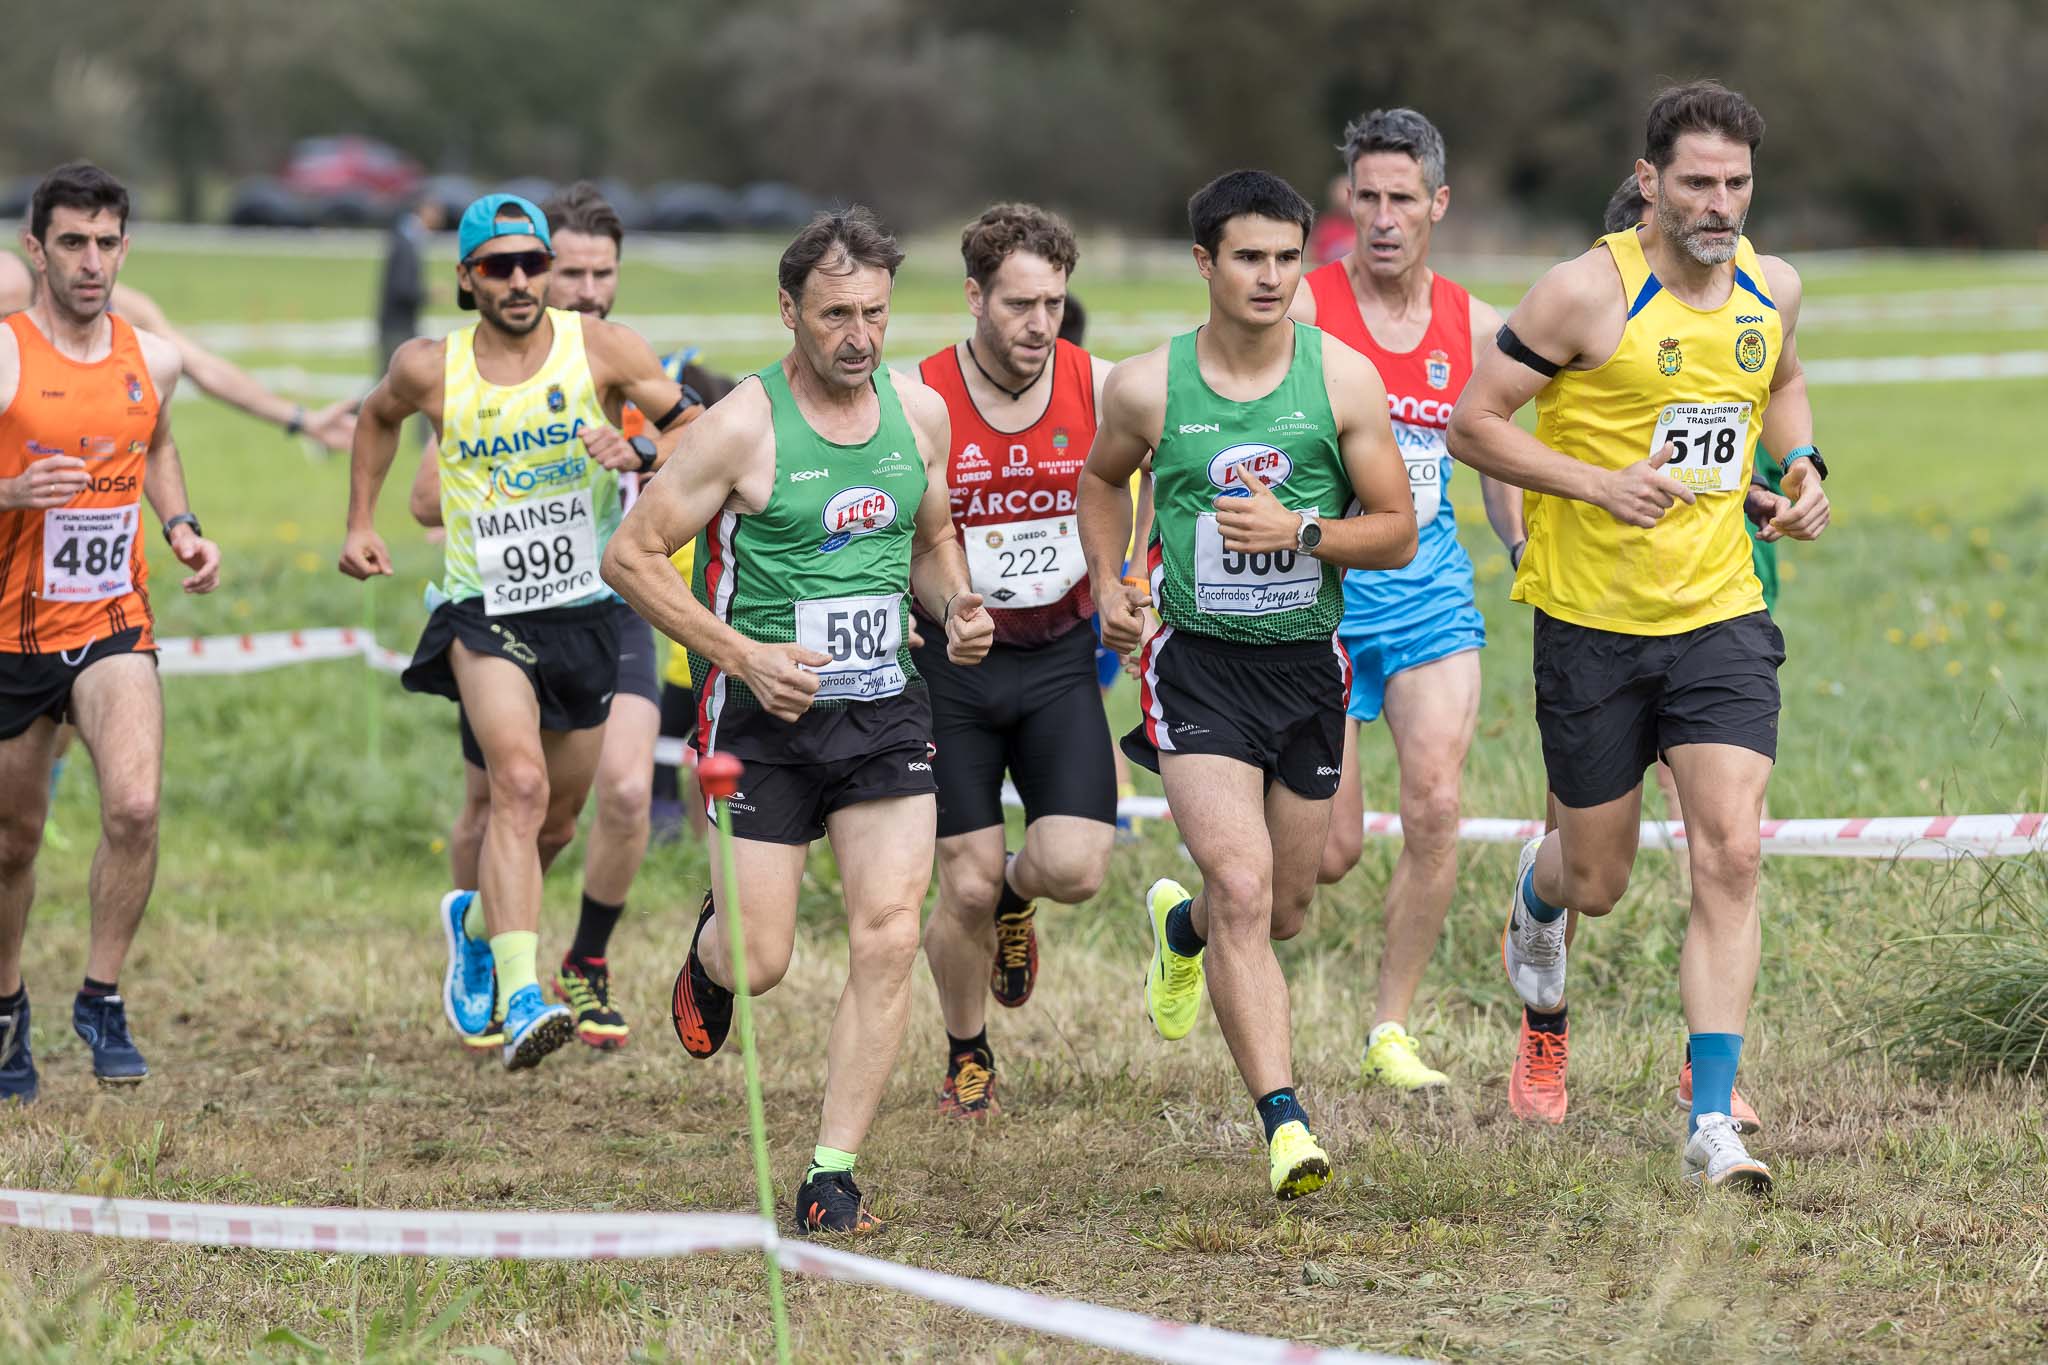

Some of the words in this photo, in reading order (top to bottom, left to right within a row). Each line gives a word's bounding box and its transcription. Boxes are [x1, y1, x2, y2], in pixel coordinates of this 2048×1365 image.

[1700, 406, 1739, 415] ATLETISMO
[1687, 416, 1727, 425] TRASMERA
[459, 418, 587, 459] MAINSA
[1665, 427, 1736, 466] 518
[956, 470, 993, 484] LOREDO
[1002, 466, 1035, 478] Beco
[1408, 463, 1437, 481] CO
[86, 475, 137, 493] NOSA
[477, 497, 587, 538] MAINSA
[836, 494, 886, 530] LUCA
[1013, 530, 1047, 542] LOREDO
[53, 533, 129, 577] 486
[503, 535, 574, 583] 998
[999, 546, 1060, 578] 222
[494, 570, 592, 606] Sapporo
[1199, 585, 1250, 601] Encofrados
[827, 608, 888, 661] 582
[819, 674, 856, 688] ofrados
[728, 801, 756, 813] PASIEGOS
